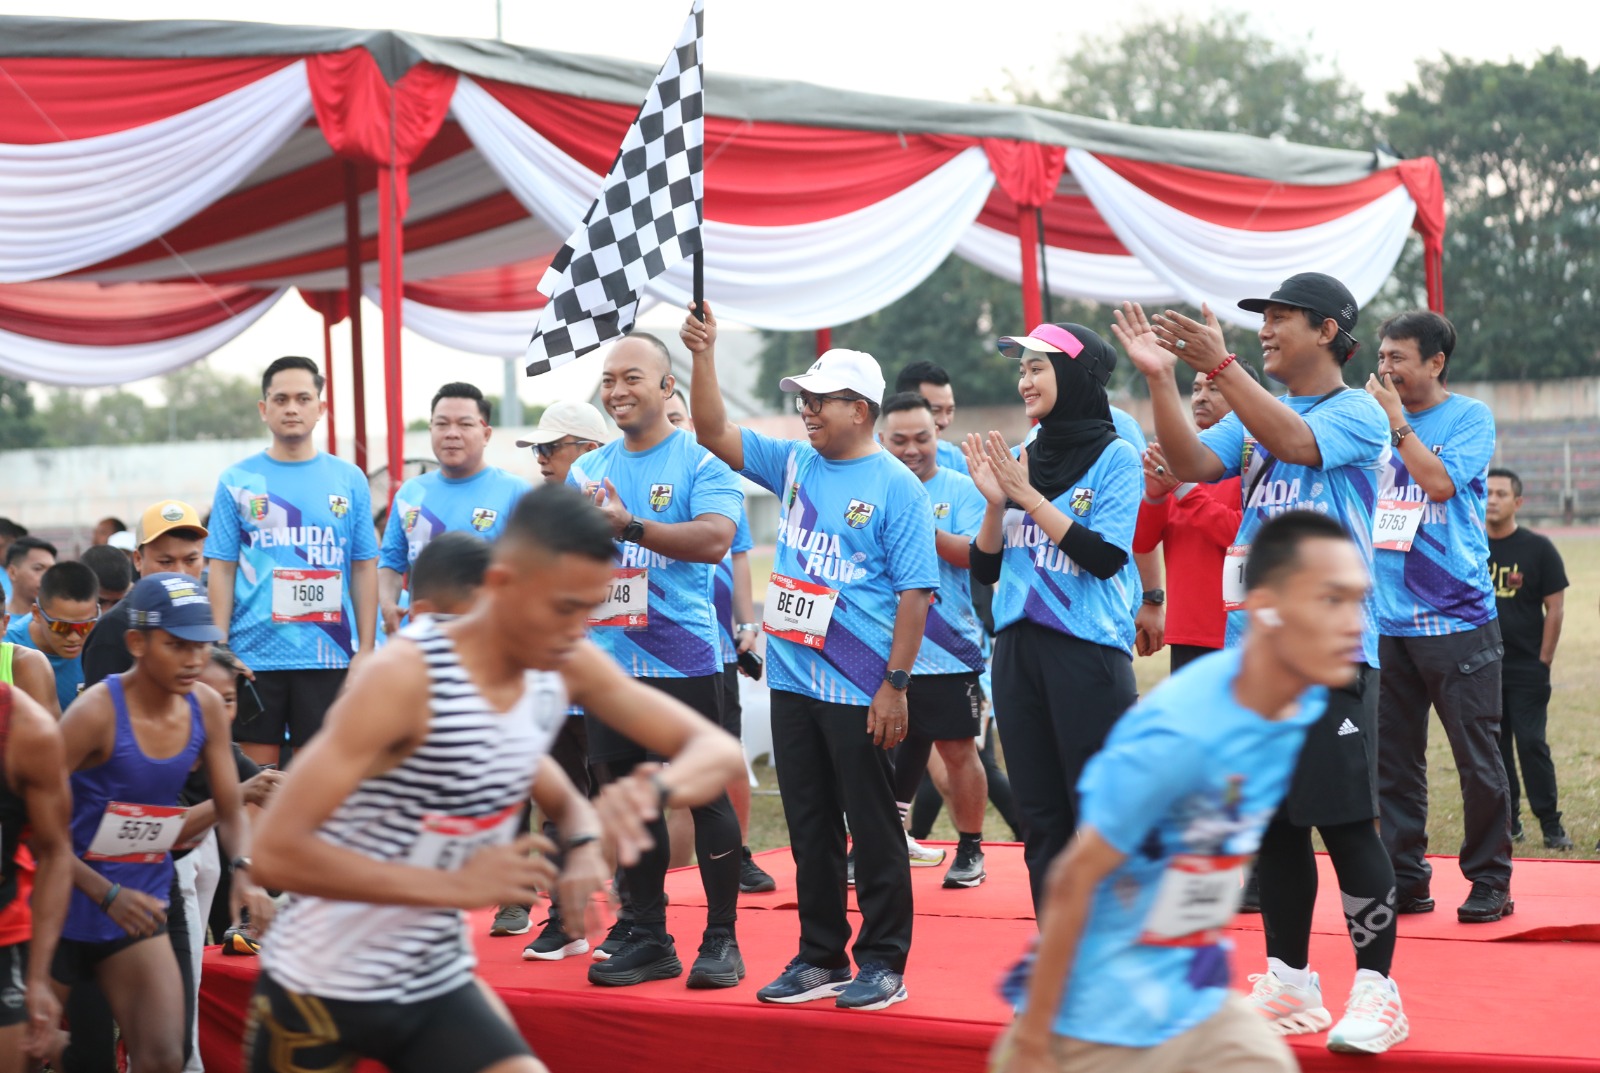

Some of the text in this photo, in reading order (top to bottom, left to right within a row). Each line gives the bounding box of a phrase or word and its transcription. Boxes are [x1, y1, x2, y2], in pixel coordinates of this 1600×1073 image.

[847, 506, 869, 528] knpi
[1378, 513, 1407, 531] 5753
[250, 526, 335, 550] PEMUDA
[804, 553, 855, 584] RUN
[292, 585, 324, 602] 1508
[600, 584, 630, 604] 748
[777, 591, 815, 619] BE 01
[804, 633, 815, 645] 5K
[117, 820, 163, 841] 5579
